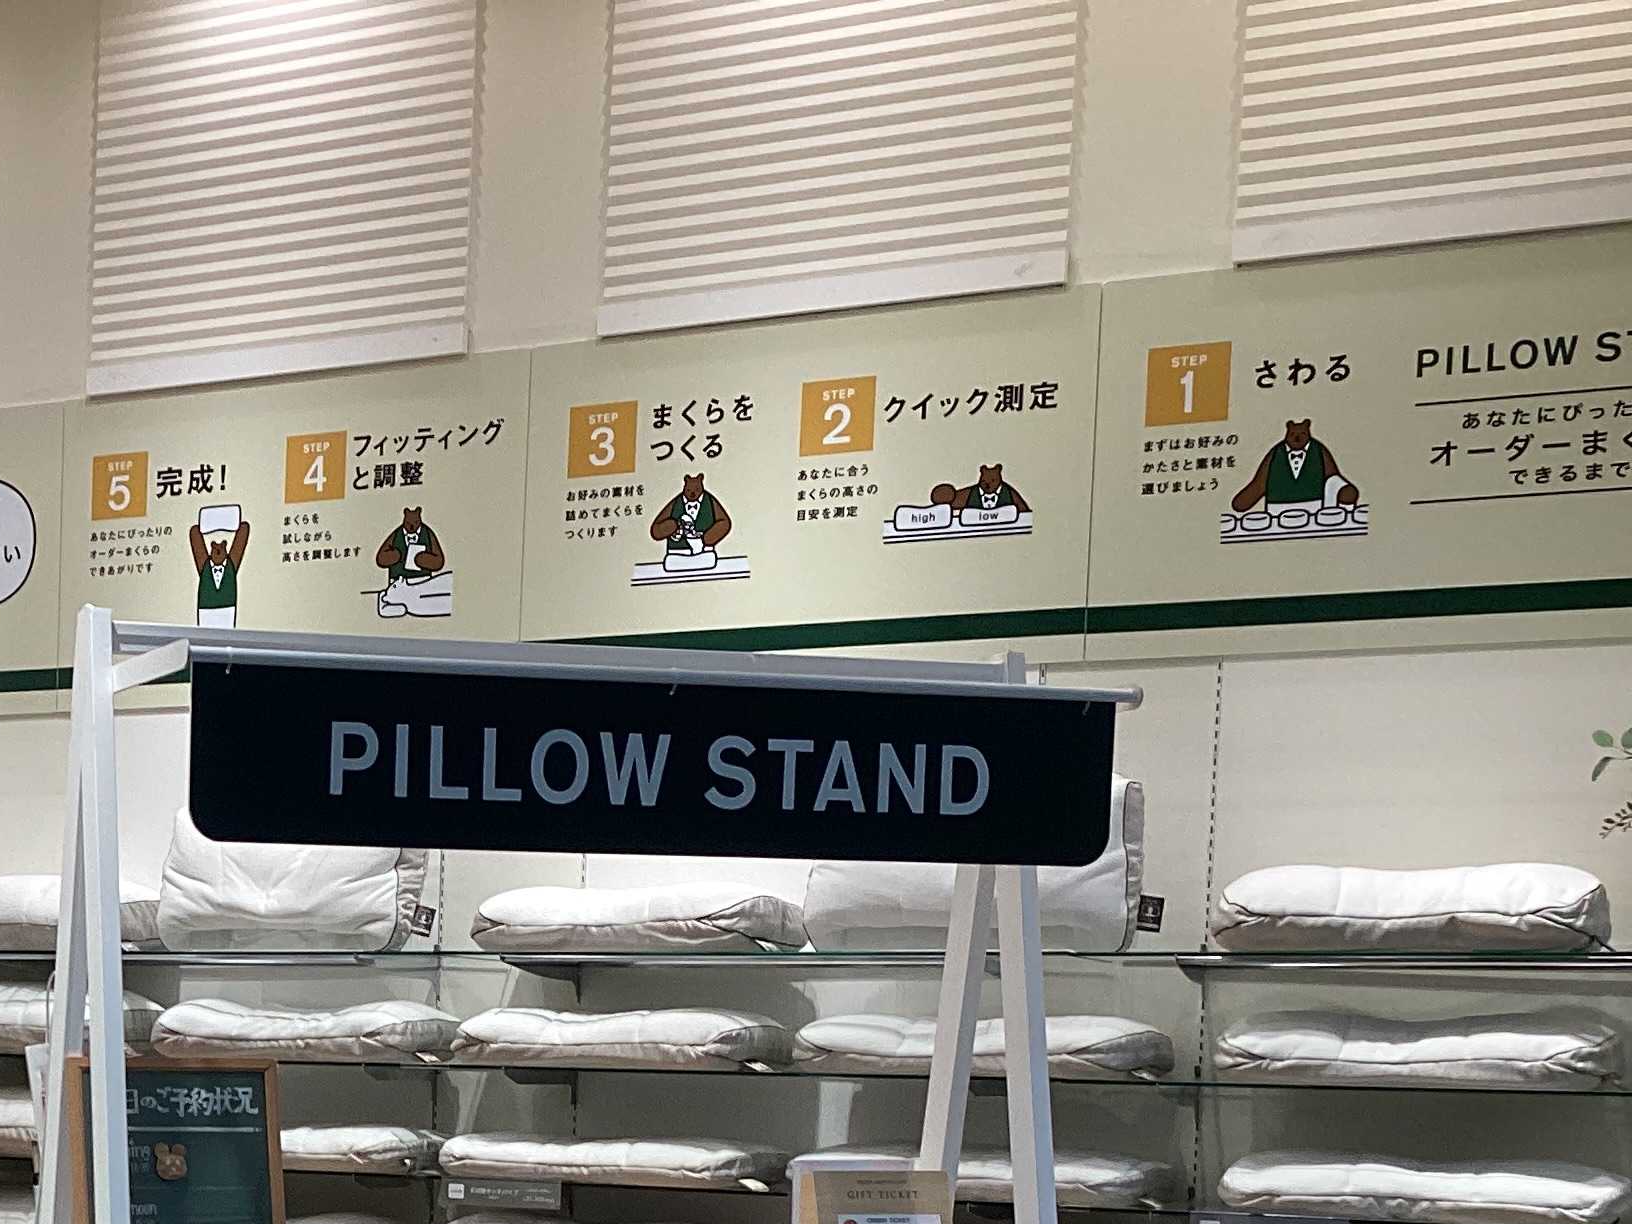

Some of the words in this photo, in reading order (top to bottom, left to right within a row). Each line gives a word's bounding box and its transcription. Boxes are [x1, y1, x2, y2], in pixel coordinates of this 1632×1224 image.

[1171, 354, 1208, 369] STEP
[1416, 334, 1579, 378] PILLOW
[1595, 330, 1632, 362] S
[1255, 354, 1351, 389] さわる
[823, 388, 855, 401] STEP
[1180, 370, 1194, 414] 1
[883, 381, 1060, 423] クイック測定
[589, 412, 618, 425] STEP
[652, 394, 754, 429] まくらを
[822, 403, 852, 445] 2
[353, 418, 505, 457] フィッティング
[589, 426, 615, 467] 3
[1144, 434, 1239, 453] まずはお好みの
[303, 441, 330, 454] STEP
[650, 433, 723, 462] つくる
[108, 460, 133, 472] STEP
[303, 455, 327, 492] 4
[797, 464, 869, 482] あなたに合う
[1142, 456, 1237, 474] かたさと素材を
[1509, 461, 1631, 485] できるまで
[156, 464, 226, 498] 完成!
[352, 461, 424, 490] と調整
[108, 474, 131, 511] 5
[567, 484, 645, 501] お好みの素材を
[797, 484, 878, 501] まくらの高さの
[1141, 478, 1219, 496] 選びましょう
[283, 513, 320, 526] まくらを
[565, 504, 643, 521] 詰めてまくらを
[796, 505, 858, 521] 目安を測定
[911, 512, 936, 524] high
[978, 510, 999, 521] low
[90, 526, 172, 542] あなたにぴったりの
[282, 531, 332, 545] 試しながら
[565, 525, 618, 540] つくります
[89, 545, 160, 559] オーダーまくらの
[282, 546, 362, 563] 高さを調整します
[89, 562, 153, 577] できあがりです
[330, 720, 671, 807] PILLOW
[704, 734, 991, 816] STAND
